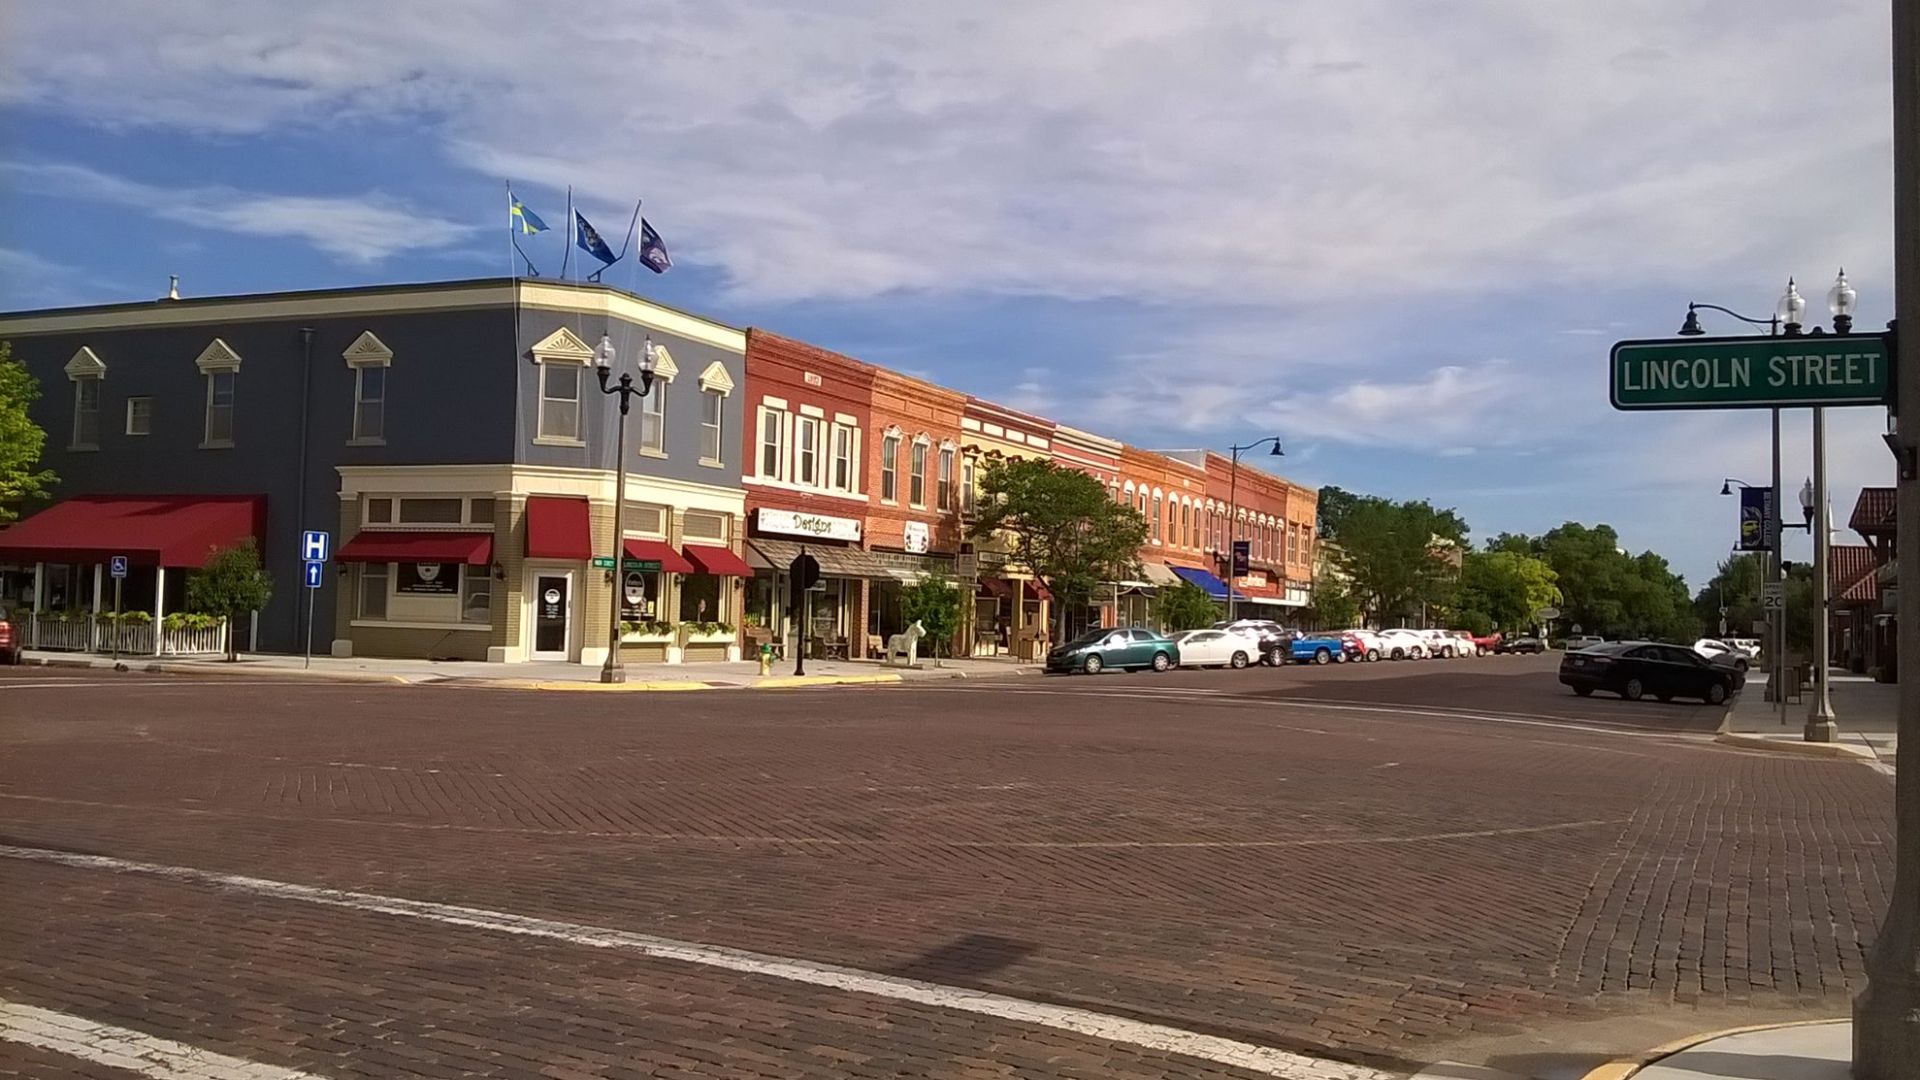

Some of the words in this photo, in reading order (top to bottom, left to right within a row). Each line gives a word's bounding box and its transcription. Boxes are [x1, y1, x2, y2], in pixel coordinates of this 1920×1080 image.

[1624, 357, 1750, 391] LINCOLN
[1767, 353, 1881, 387] STREET
[792, 514, 832, 535] Designs
[306, 533, 325, 559] H
